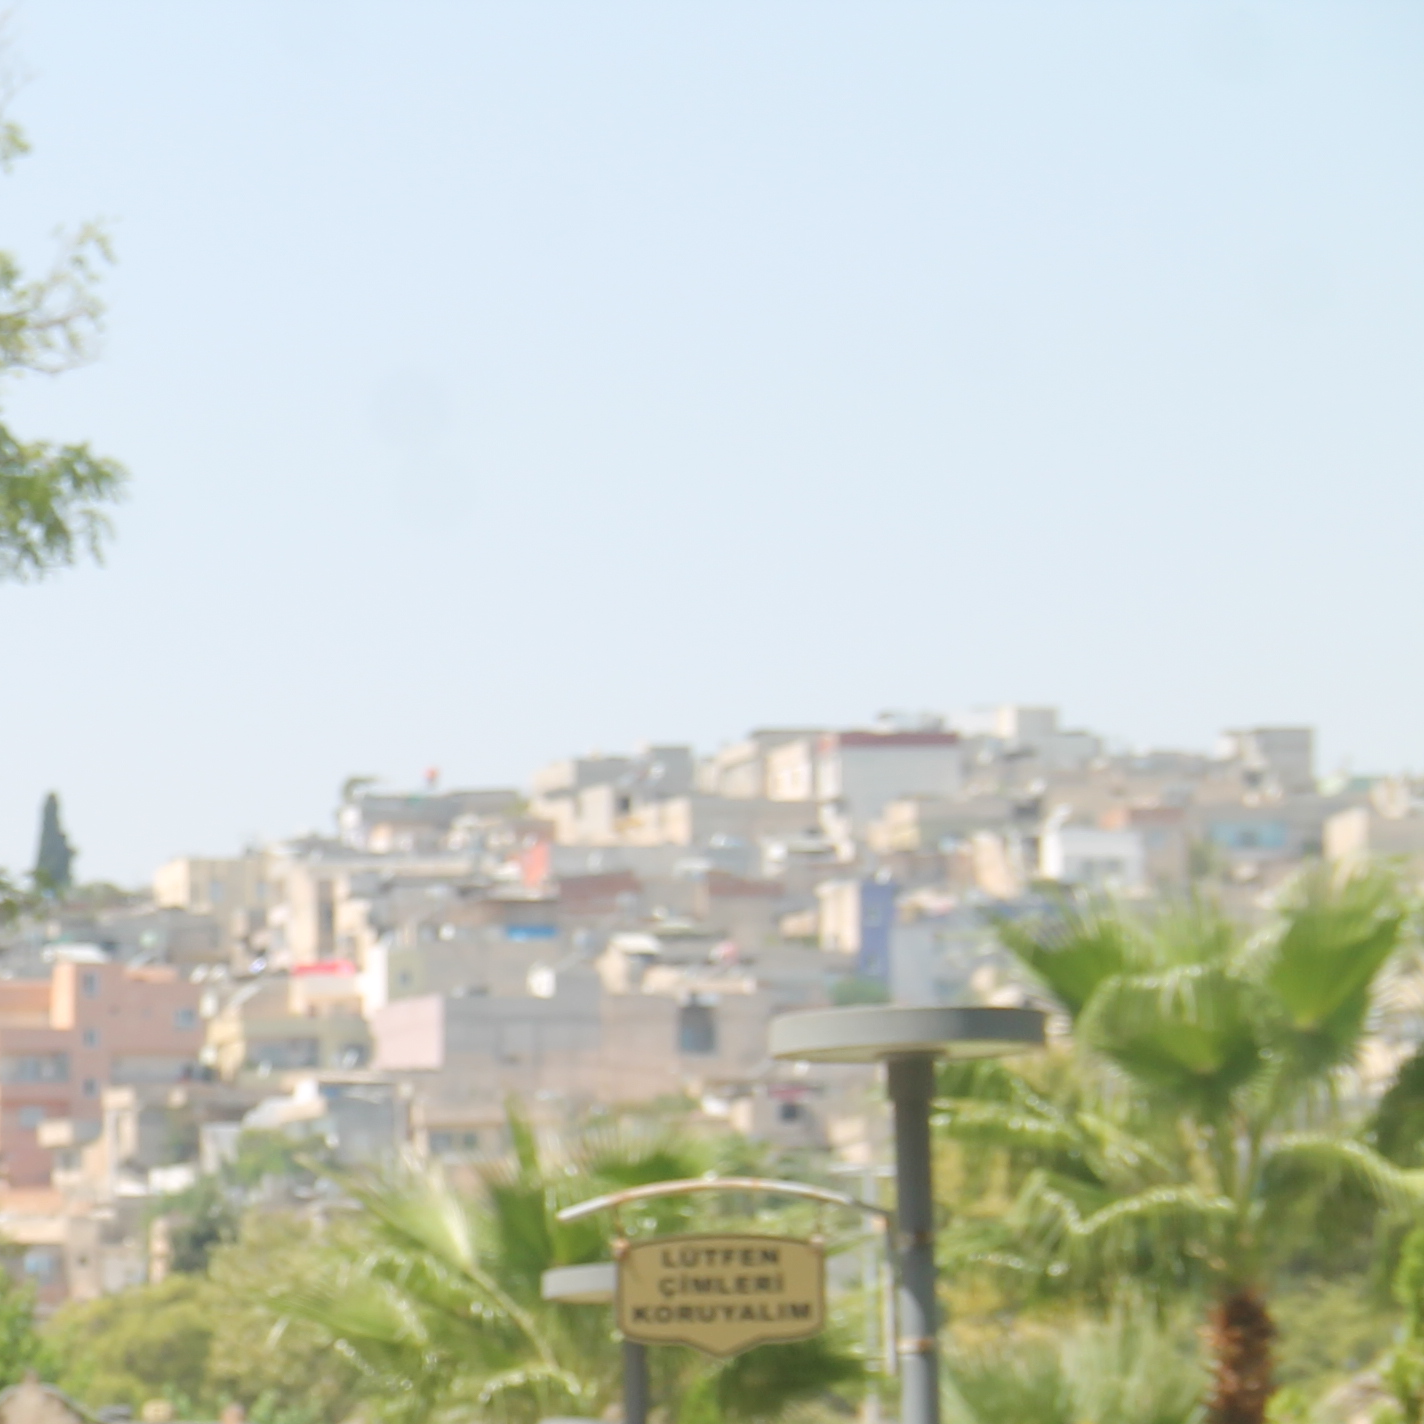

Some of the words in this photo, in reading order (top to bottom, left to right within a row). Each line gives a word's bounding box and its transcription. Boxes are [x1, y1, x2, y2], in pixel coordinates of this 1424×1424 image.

[662, 1247, 779, 1268] LÜTFEN
[659, 1273, 784, 1298] ÇİMLERİ
[633, 1303, 810, 1324] KORUYALIM
